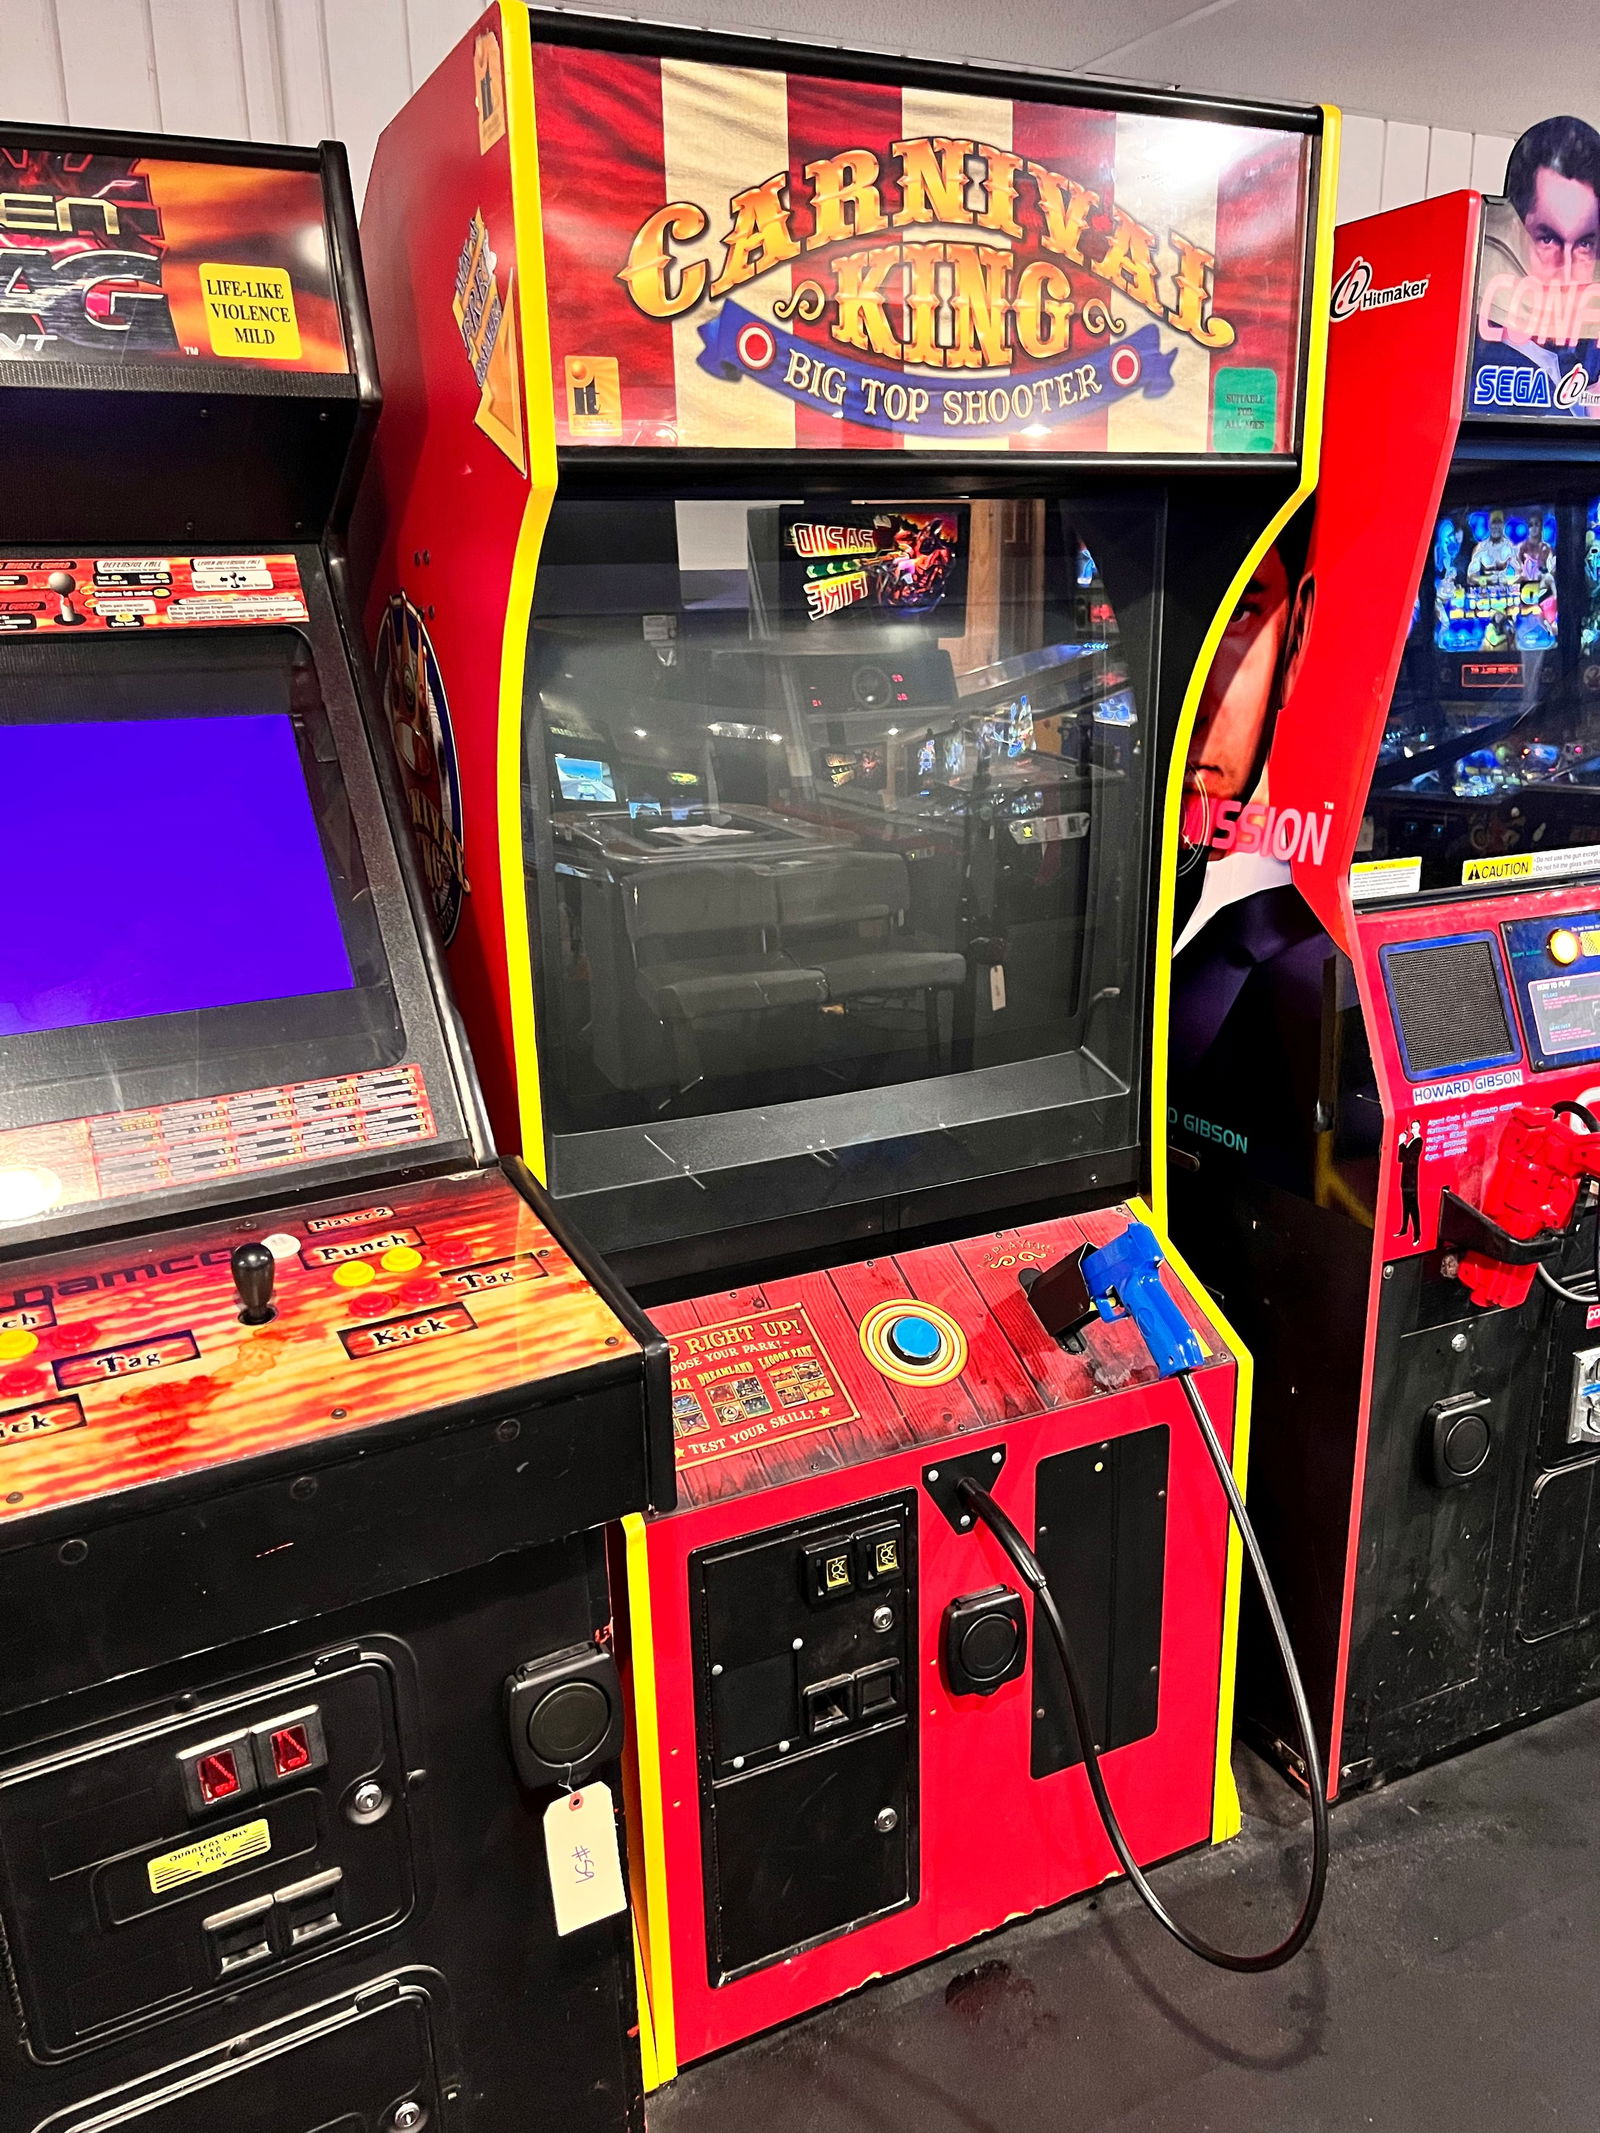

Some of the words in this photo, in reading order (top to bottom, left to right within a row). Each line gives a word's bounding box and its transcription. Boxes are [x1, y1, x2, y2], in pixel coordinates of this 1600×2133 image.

[614, 136, 1237, 350] CARNIVAL
[206, 279, 285, 300] LIFE-LIKE
[1362, 279, 1427, 308] Hitmaker
[210, 301, 291, 323] VIOLENCE
[830, 241, 1075, 370] KING
[234, 326, 276, 345] MILD
[783, 348, 847, 406] BIG
[859, 377, 928, 424] TOP
[942, 362, 1103, 426] SHOOTER
[1225, 393, 1265, 404] SUITABLE
[1475, 365, 1551, 407] SEGA
[1481, 861, 1529, 879] CAUTION
[1414, 1079, 1471, 1102] HOWARD
[1474, 1071, 1522, 1091] GIBSON
[1183, 1113, 1248, 1154] GIBSON
[313, 1212, 371, 1230] Player
[377, 1207, 389, 1217] 2
[317, 1234, 407, 1261] Punch
[992, 1240, 1056, 1254] PLAYERS
[457, 1271, 514, 1288] Tag
[372, 1318, 448, 1346] Kick
[685, 1325, 754, 1355] RIGHT
[760, 1319, 803, 1337] UP!
[95, 1351, 162, 1373] Tag
[705, 1347, 739, 1363] YOUR
[740, 1340, 783, 1354] PARK!
[758, 1350, 791, 1371] LAGOON
[696, 1361, 755, 1388] DREAMLAND
[688, 1438, 727, 1455] TEST
[729, 1423, 768, 1445] YOUR
[769, 1409, 816, 1429] SKILL!
[169, 1839, 220, 1862] QUARTERS
[223, 1829, 249, 1842] ONLY
